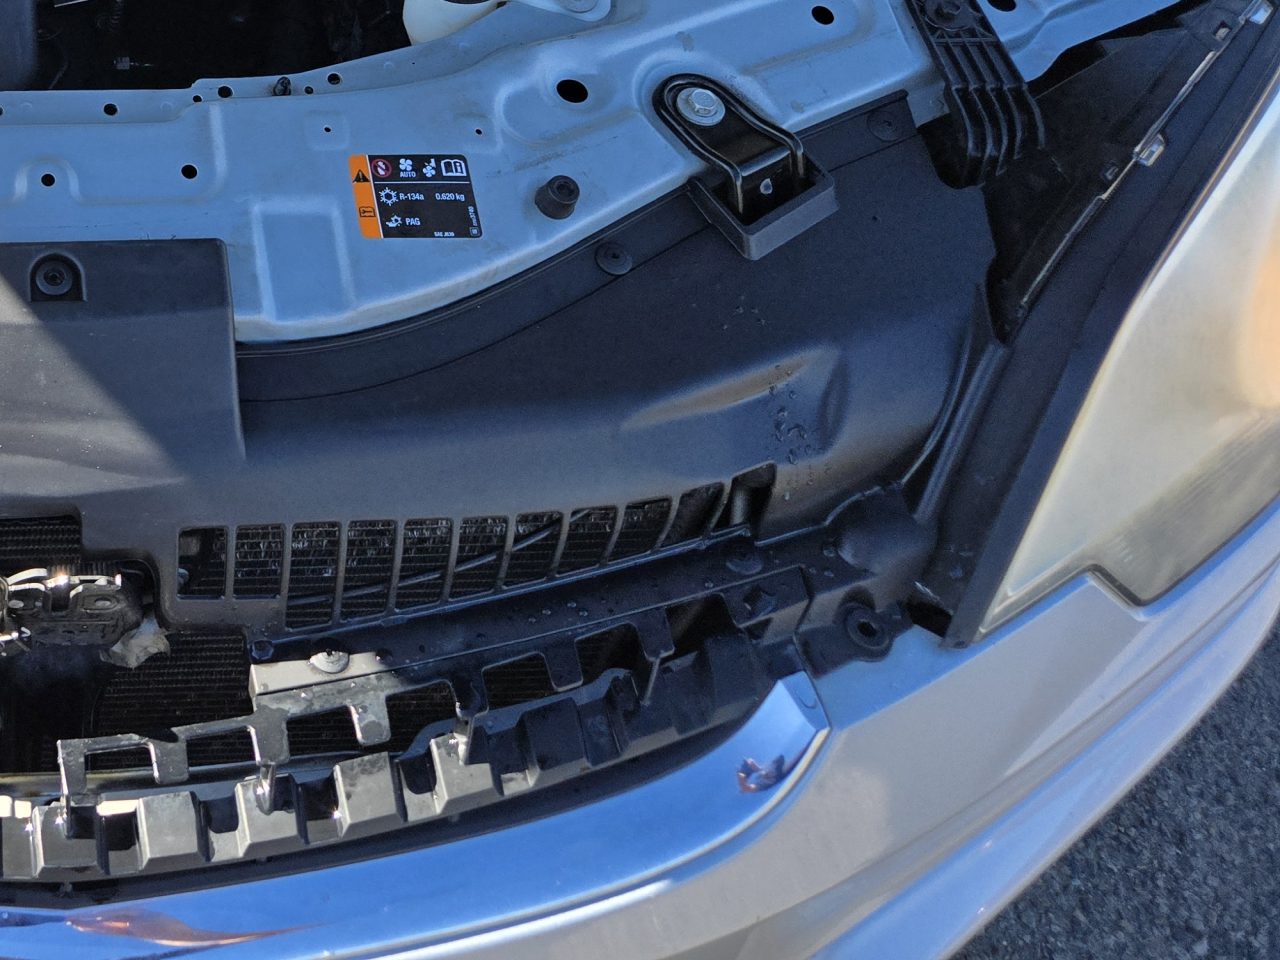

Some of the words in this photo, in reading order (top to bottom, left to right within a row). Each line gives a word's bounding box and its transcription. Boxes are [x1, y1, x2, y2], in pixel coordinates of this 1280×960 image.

[399, 192, 425, 200] R-134a
[435, 192, 455, 200] 0.620
[456, 192, 465, 202] kg
[405, 217, 421, 226] PAG
